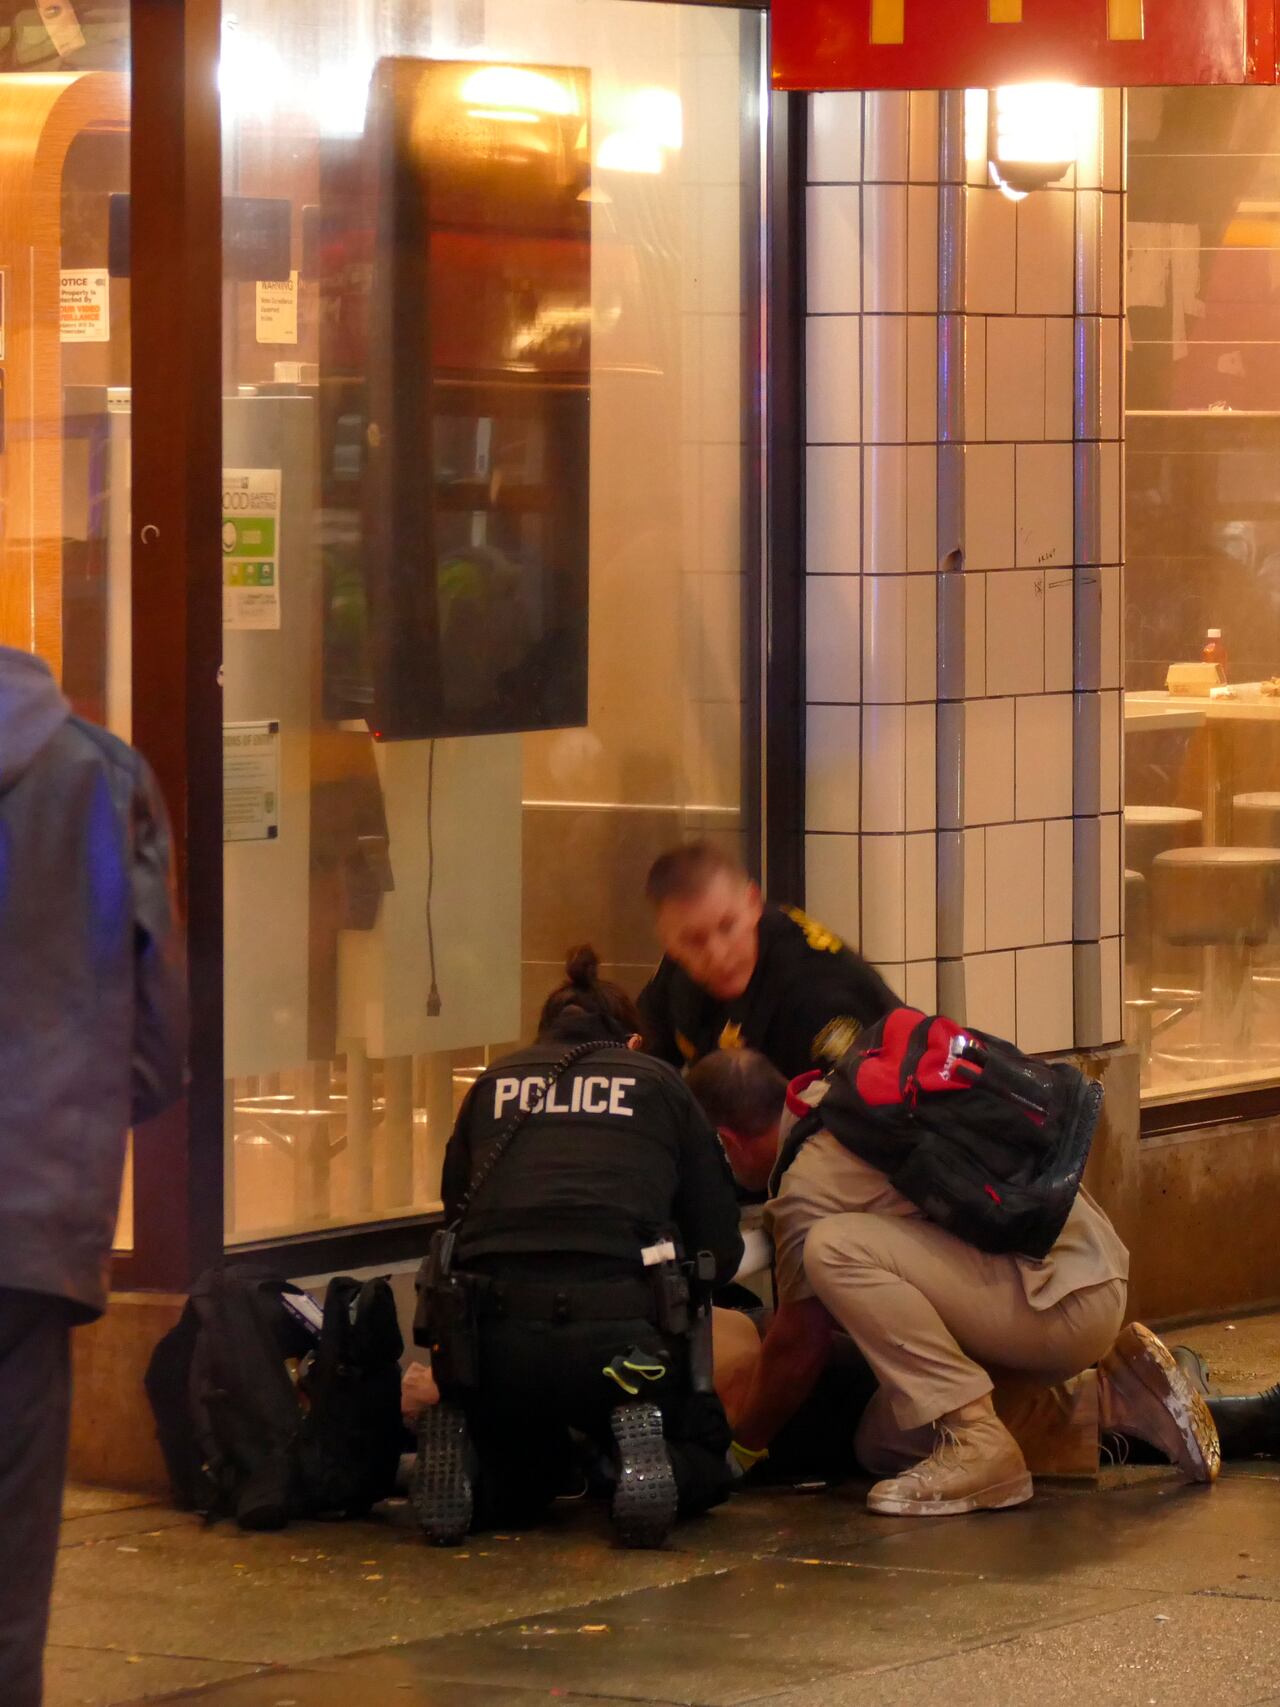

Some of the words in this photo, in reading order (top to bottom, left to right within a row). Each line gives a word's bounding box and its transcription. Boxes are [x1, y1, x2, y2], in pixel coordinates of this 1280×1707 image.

[61, 278, 88, 286] OTICE
[223, 492, 249, 510] OOD
[494, 1076, 636, 1120] POLICE
